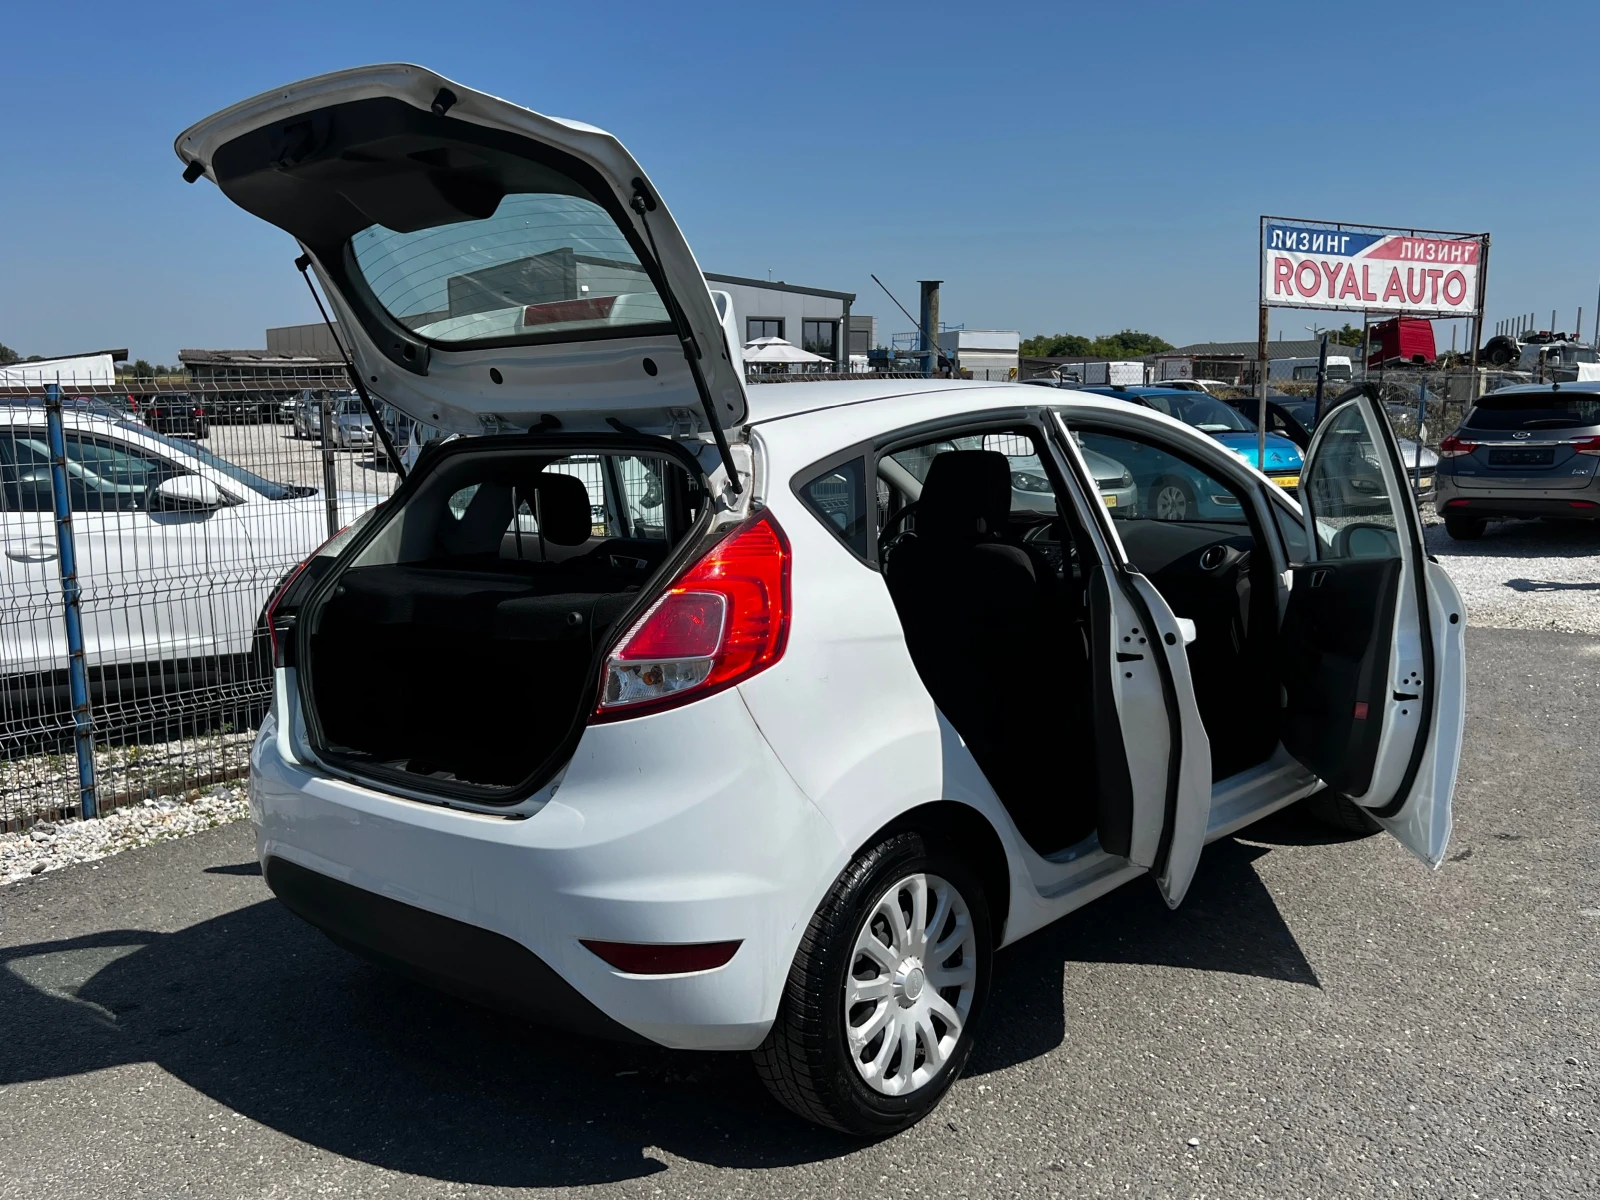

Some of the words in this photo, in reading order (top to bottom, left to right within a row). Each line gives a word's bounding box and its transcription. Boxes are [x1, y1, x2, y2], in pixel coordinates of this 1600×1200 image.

[1271, 229, 1350, 254] ЛИЗИНГ
[1400, 241, 1474, 263] ЛИЗИНГ
[1274, 256, 1377, 302] ROYAL
[1383, 266, 1467, 305] AUTO
